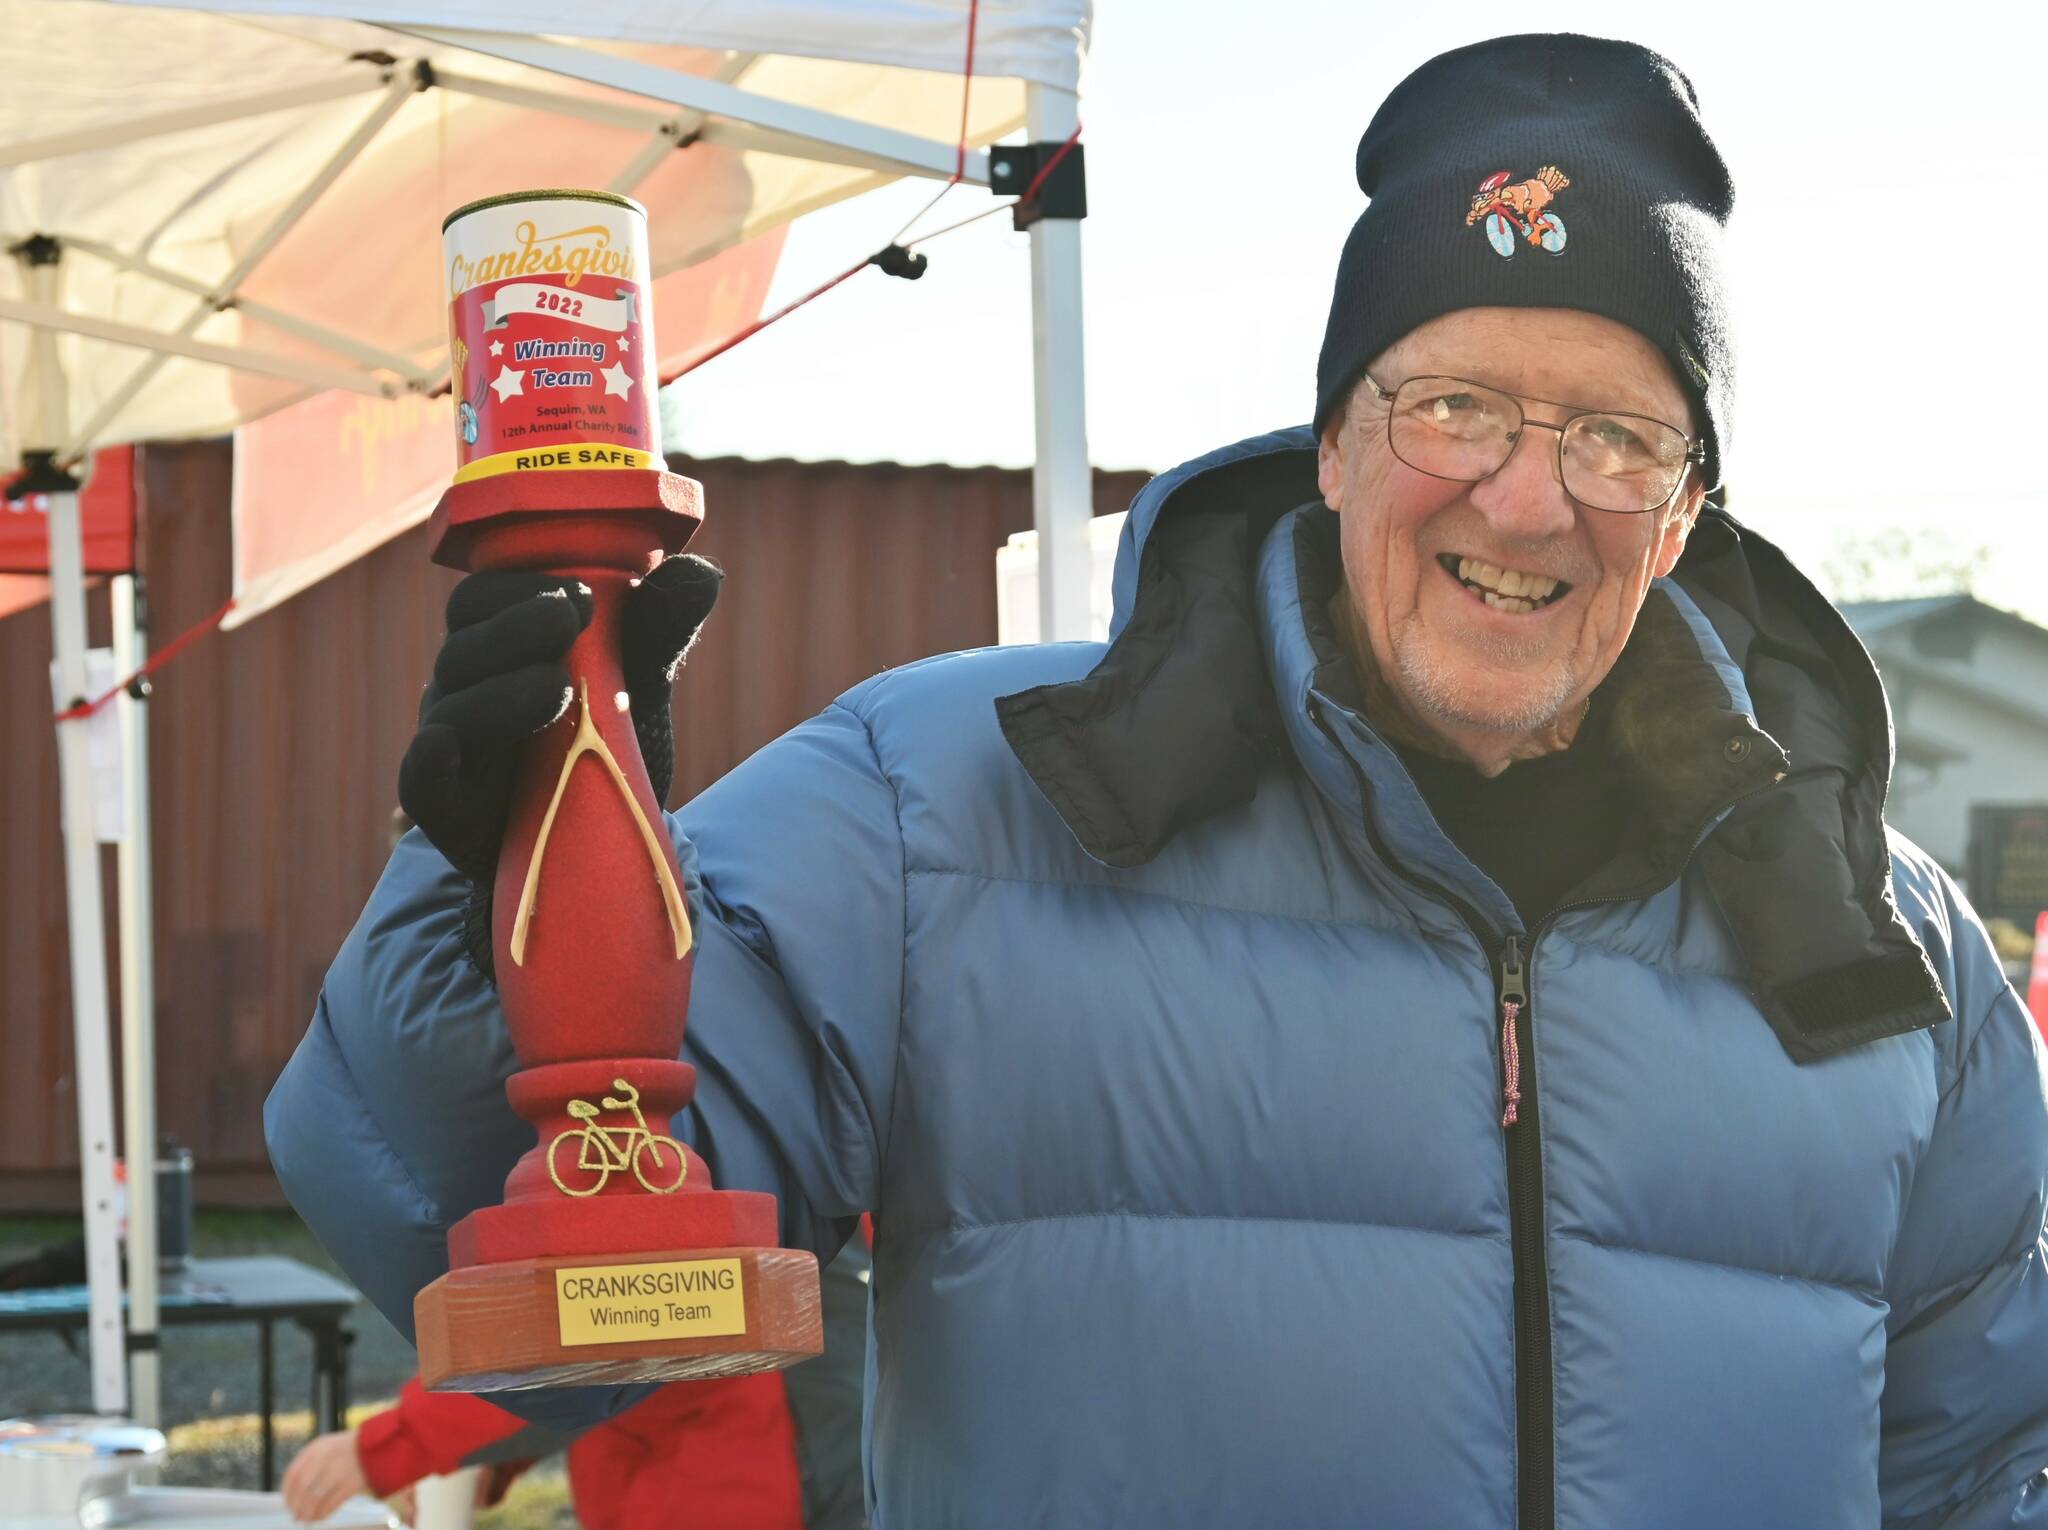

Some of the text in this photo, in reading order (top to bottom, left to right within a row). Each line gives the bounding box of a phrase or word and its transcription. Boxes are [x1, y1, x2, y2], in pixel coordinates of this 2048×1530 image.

[536, 291, 583, 318] 2022
[514, 337, 605, 362] Winning
[532, 369, 592, 388] Team
[536, 404, 606, 417] Sequim, WA
[501, 420, 638, 439] 12th Annual Charity Ride
[516, 449, 636, 470] RIDE SAFE
[563, 1269, 735, 1300] CRANKSGIVING
[590, 1303, 712, 1327] Winning Team
